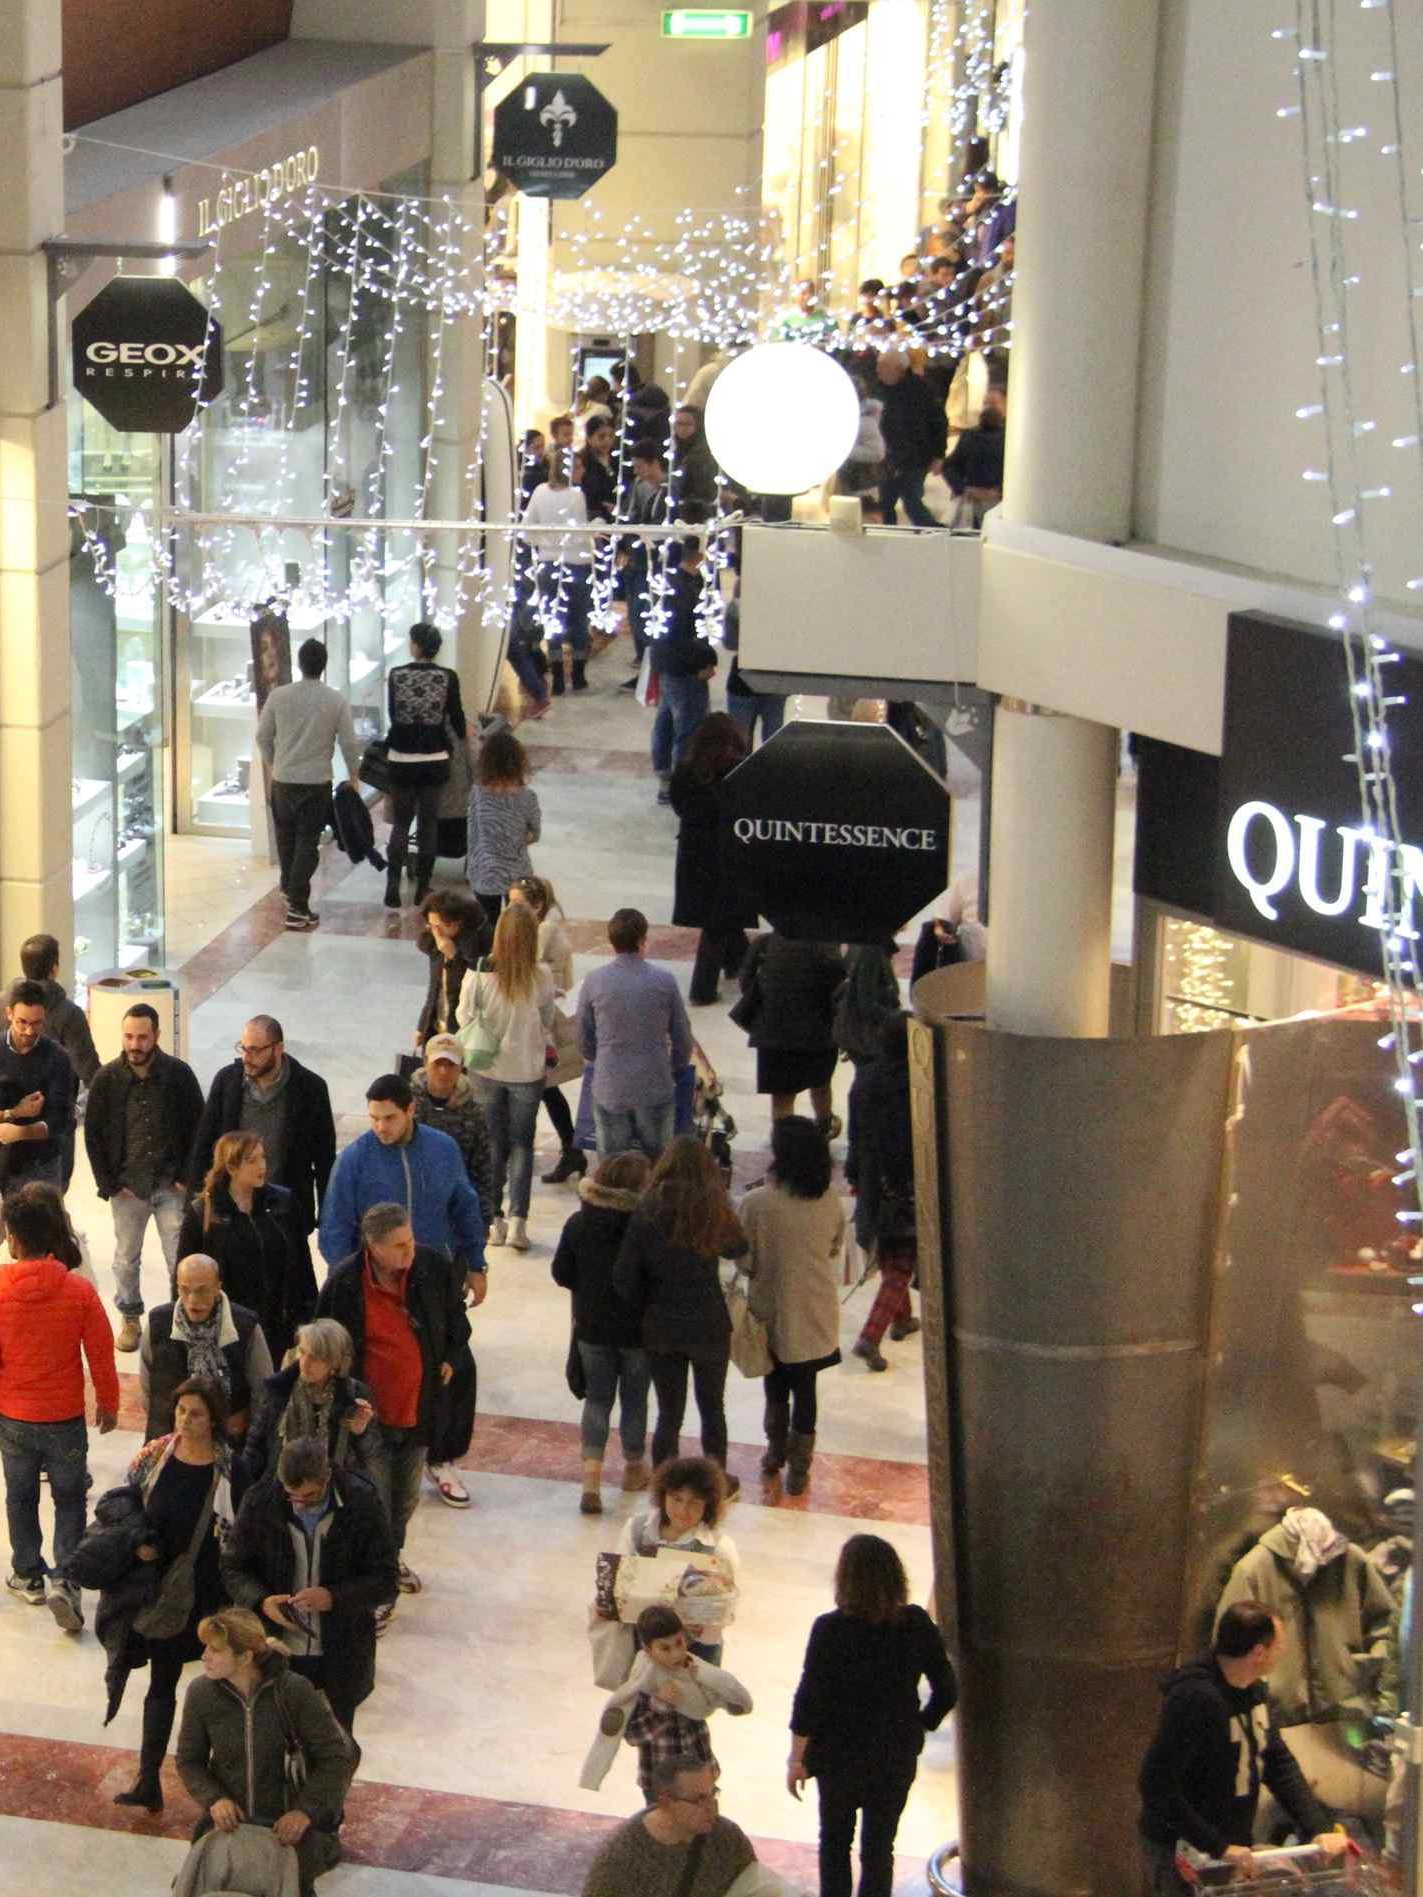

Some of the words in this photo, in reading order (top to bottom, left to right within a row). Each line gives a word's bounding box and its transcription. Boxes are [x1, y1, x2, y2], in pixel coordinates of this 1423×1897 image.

[503, 155, 515, 167] IL
[86, 341, 206, 365] GEOX
[733, 817, 937, 851] QUINTESSENCE
